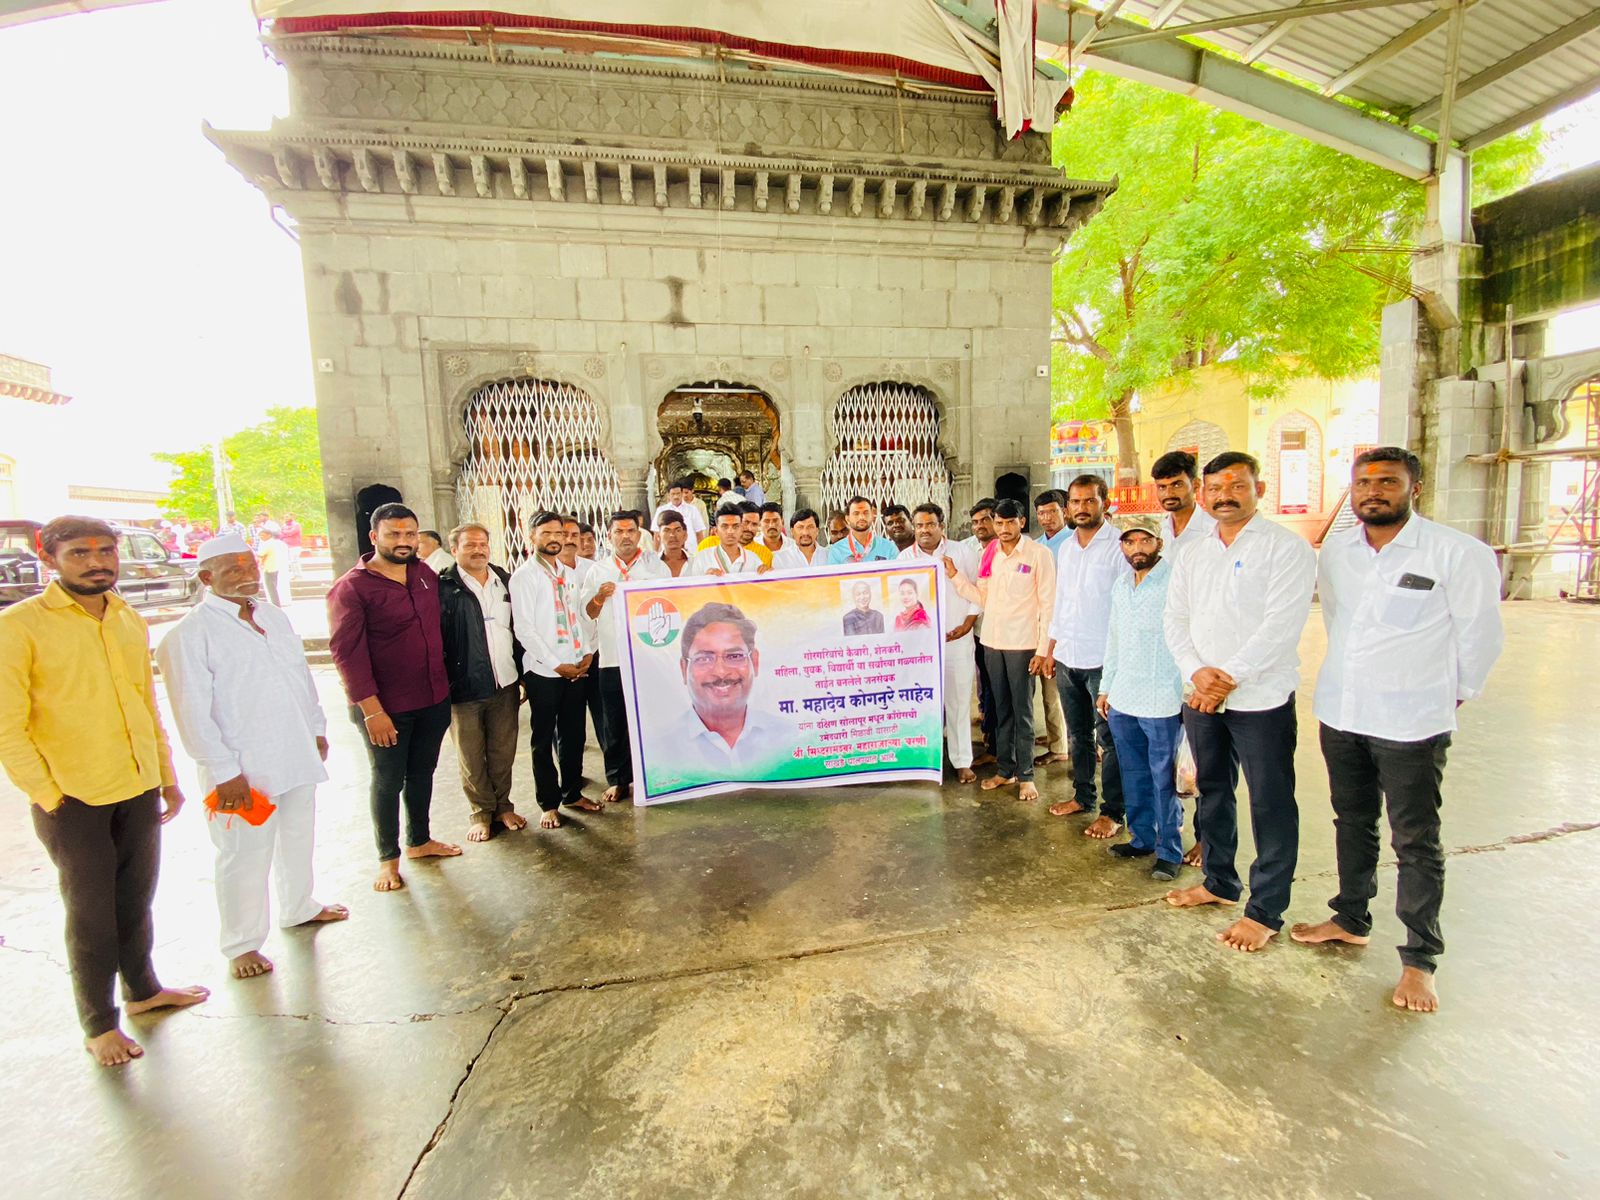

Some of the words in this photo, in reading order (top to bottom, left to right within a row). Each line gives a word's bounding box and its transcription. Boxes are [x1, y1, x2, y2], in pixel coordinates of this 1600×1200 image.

[774, 665, 801, 677] महिला,
[778, 700, 799, 713] मा.
[802, 691, 846, 715] महादेव
[849, 686, 895, 710] कोगनुरे
